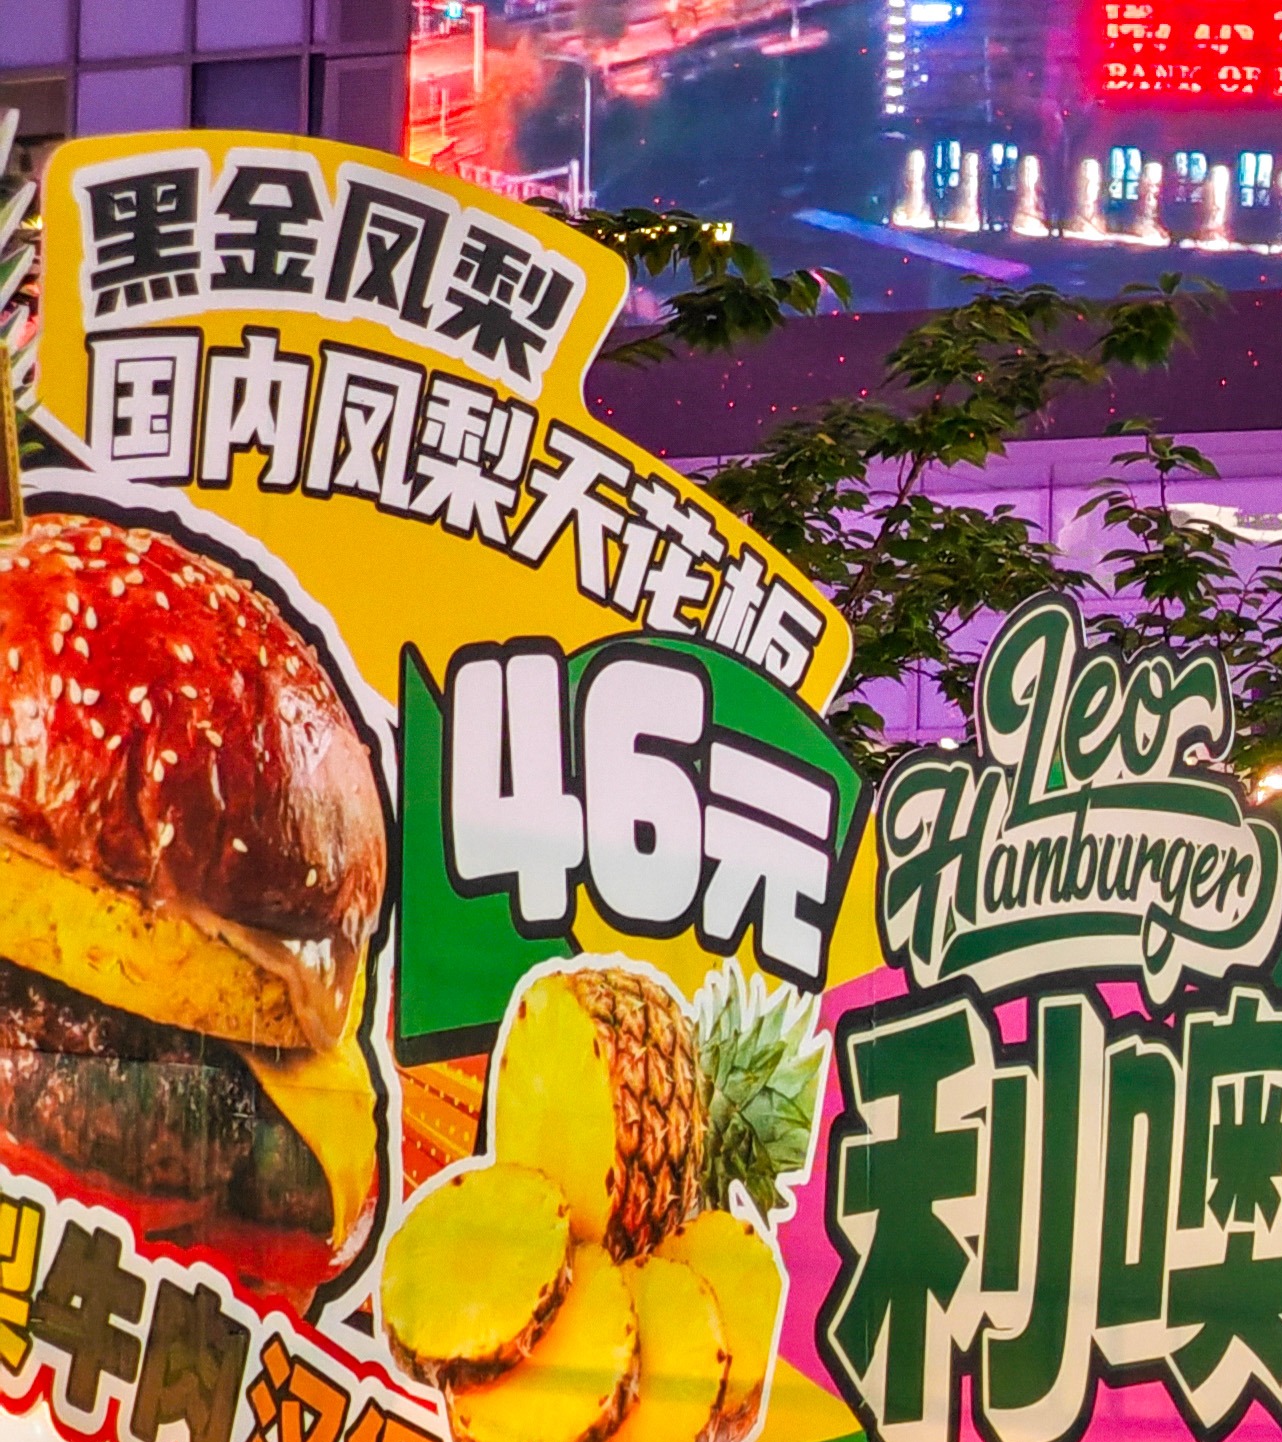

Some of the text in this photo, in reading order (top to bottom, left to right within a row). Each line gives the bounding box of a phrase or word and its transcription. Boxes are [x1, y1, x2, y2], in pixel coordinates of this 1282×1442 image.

[1105, 61, 1202, 92] BANK
[1217, 64, 1262, 94] OF
[74, 165, 575, 384] 黑金凤梨
[88, 328, 823, 688] 国内凤梨天花板
[980, 604, 1222, 790] Leo
[450, 650, 834, 980] 46元
